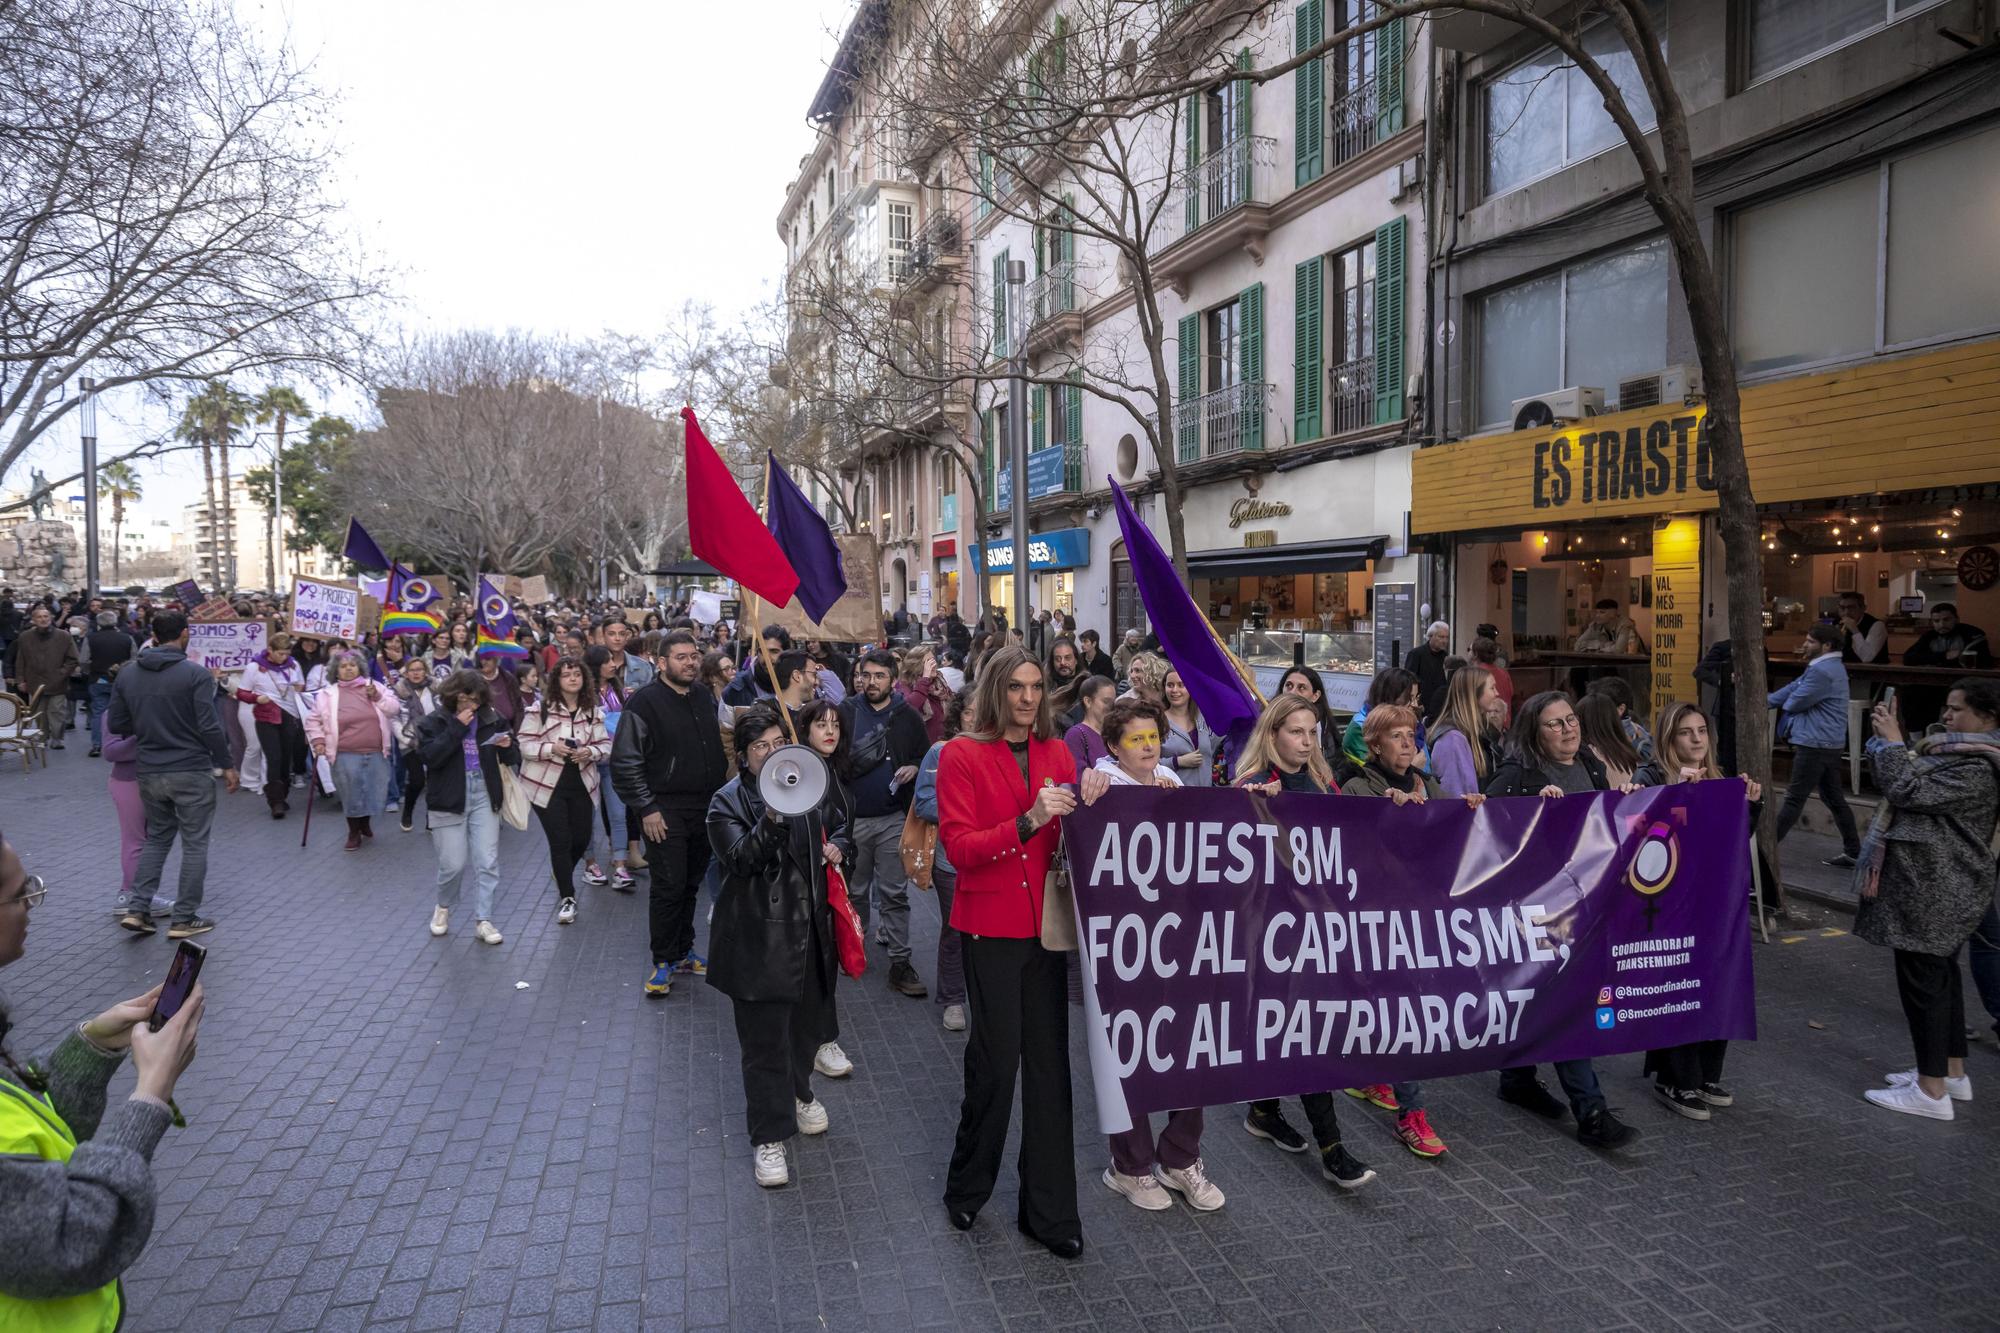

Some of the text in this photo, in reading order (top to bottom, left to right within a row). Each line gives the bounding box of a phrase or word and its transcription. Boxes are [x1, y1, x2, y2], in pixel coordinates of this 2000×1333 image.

[1533, 436, 1572, 508] ES
[1655, 576, 1672, 591] VAL
[1655, 595, 1674, 610] MÉS
[321, 612, 329, 621] A
[1655, 613, 1683, 629] MORIR
[189, 625, 238, 637] SOMOS
[1655, 634, 1676, 649] D'UN
[205, 656, 221, 668] NO
[1656, 653, 1673, 668] ROT
[1655, 673, 1673, 690] QUE
[1089, 821, 1358, 902] AQUEST 8M,
[1088, 904, 1571, 985] FOC AL CAPITALISME,
[1612, 936, 1695, 957] COORDINADORA 8M
[1616, 952, 1691, 972] TRANSFEMINISTA
[1615, 979, 1701, 999] @8mcoordinadora
[1617, 1000, 1701, 1022] @8mcoordinadora
[1186, 1001, 1242, 1070] AL
[1256, 988, 1535, 1061] PATRIARCAT
